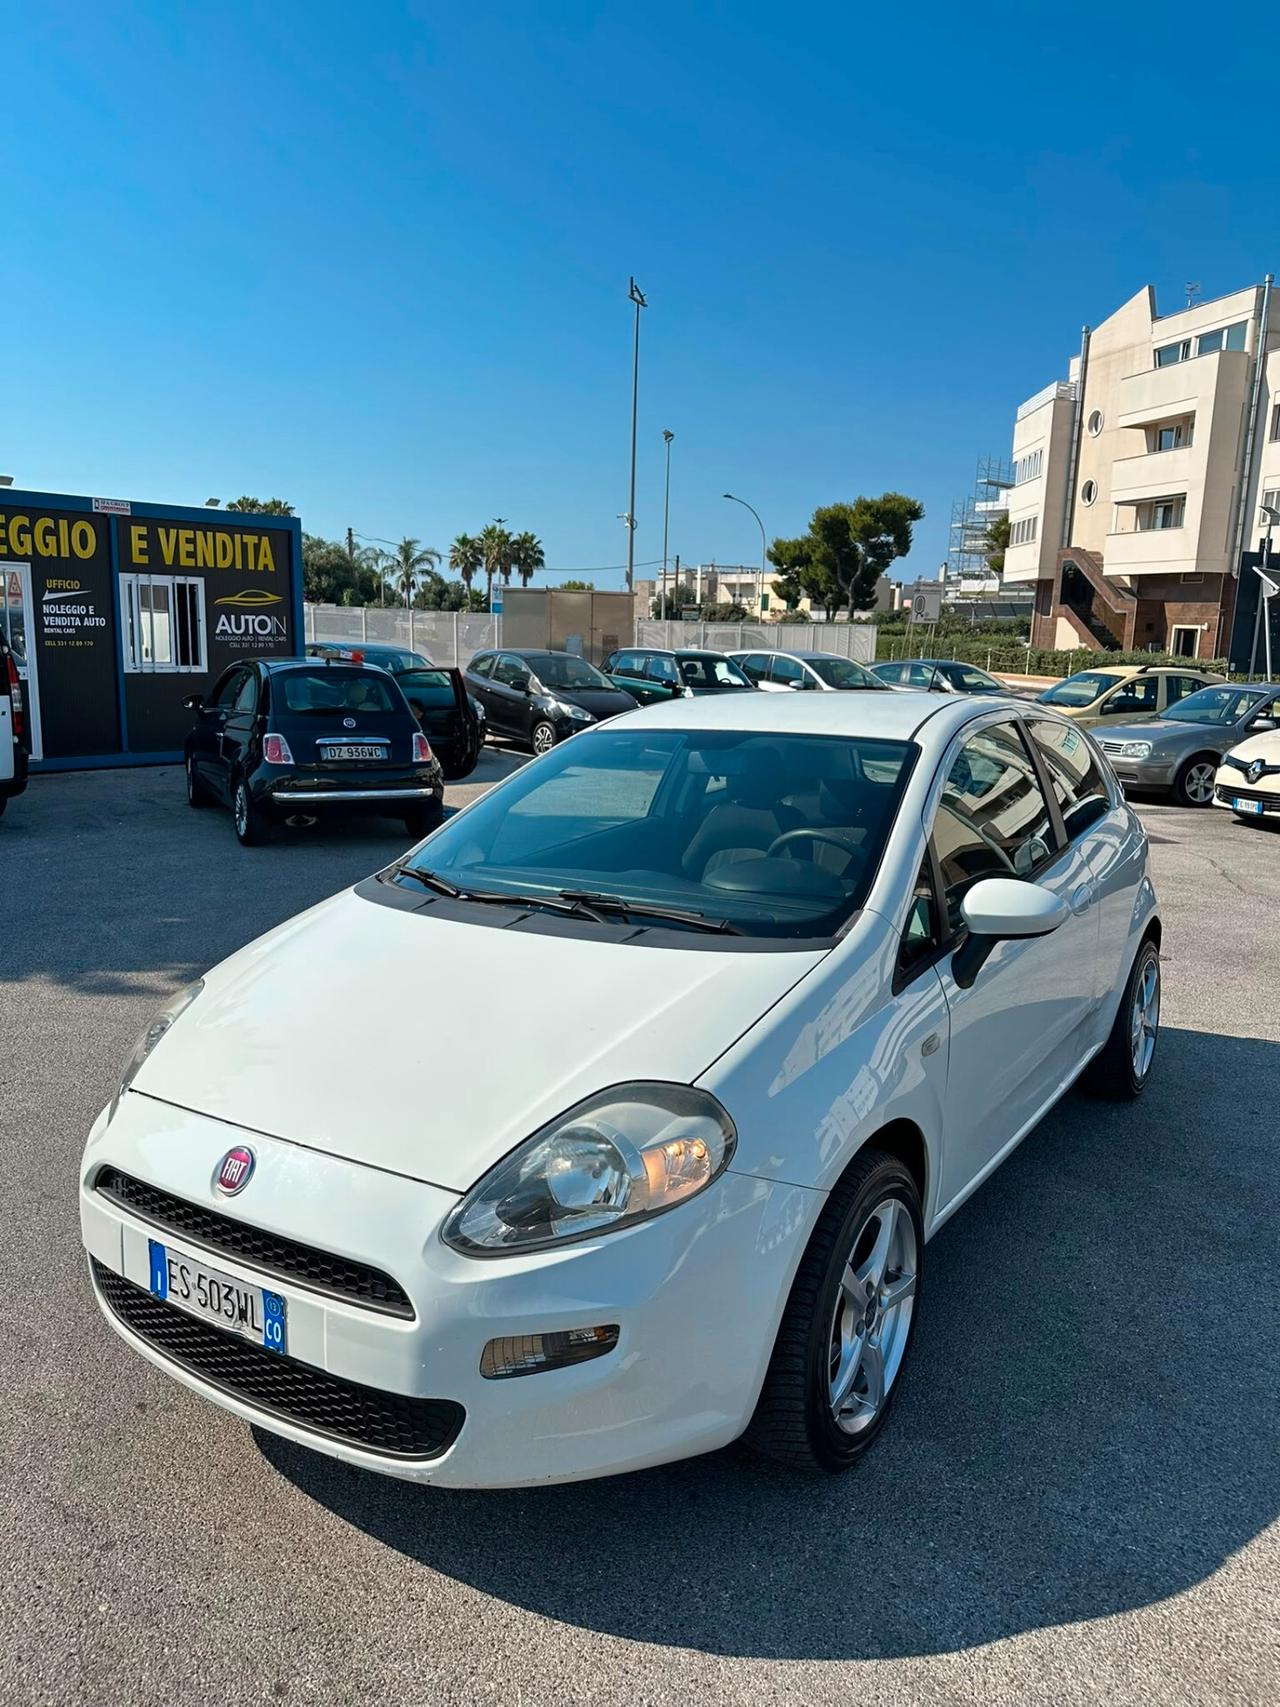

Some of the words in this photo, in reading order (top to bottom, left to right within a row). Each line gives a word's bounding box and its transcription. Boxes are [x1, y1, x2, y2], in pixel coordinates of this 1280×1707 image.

[130, 525, 149, 564] E
[157, 527, 276, 572] VENDITA
[46, 579, 81, 590] UFFICIO
[42, 604, 87, 615] NOLEGGIO
[88, 605, 95, 615] E
[43, 616, 81, 626] VENDITA
[83, 617, 106, 627] AUTO
[328, 747, 343, 758] DZ
[346, 747, 381, 759] 936WC
[221, 1157, 248, 1184] FIAT
[167, 1258, 191, 1299] ES
[197, 1272, 263, 1333] 503WL
[266, 1318, 282, 1343] CO
